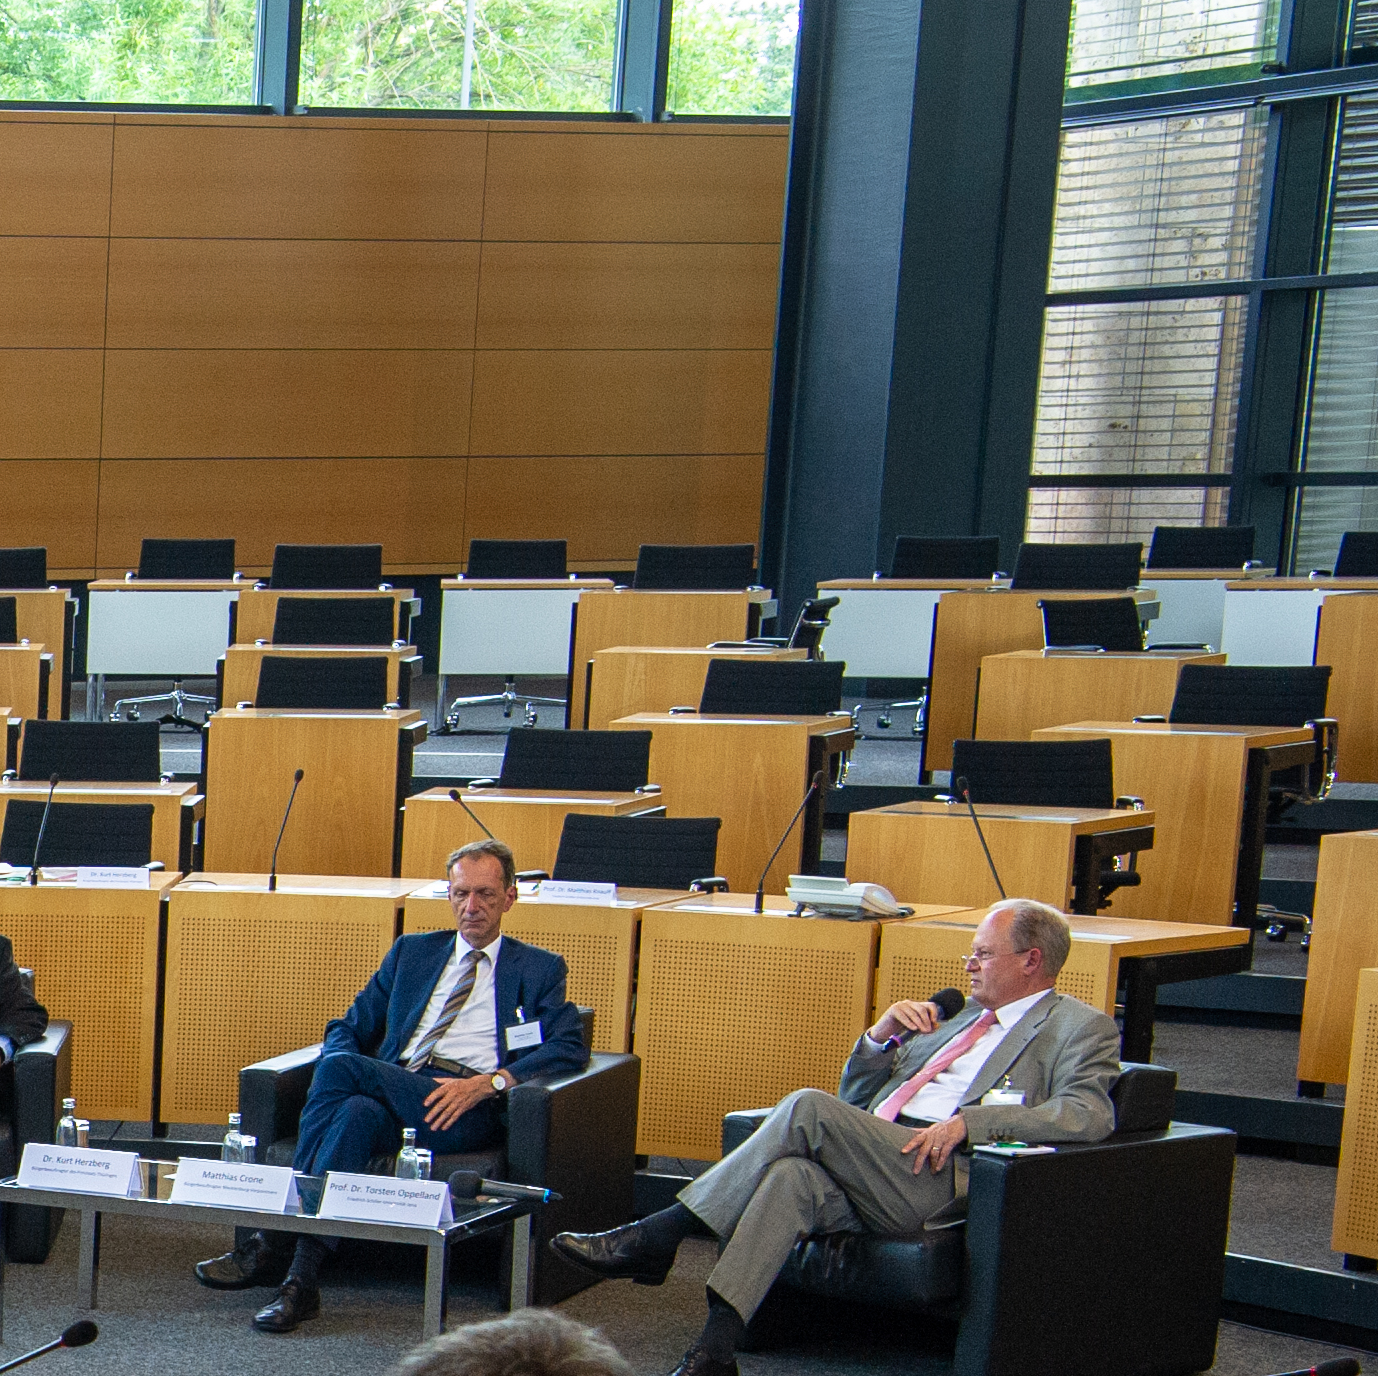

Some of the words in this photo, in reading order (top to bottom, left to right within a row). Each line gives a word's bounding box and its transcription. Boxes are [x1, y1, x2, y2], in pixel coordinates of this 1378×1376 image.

[43, 1154, 54, 1163] Dr.
[56, 1156, 73, 1165] Kurt
[75, 1158, 111, 1170] Herzberg
[202, 1170, 238, 1182] Matthias
[239, 1174, 264, 1185] Crone
[329, 1182, 349, 1192] Prof.
[350, 1184, 363, 1193] Dr.
[365, 1186, 396, 1196] Torsten
[397, 1188, 441, 1201] Oppelland
